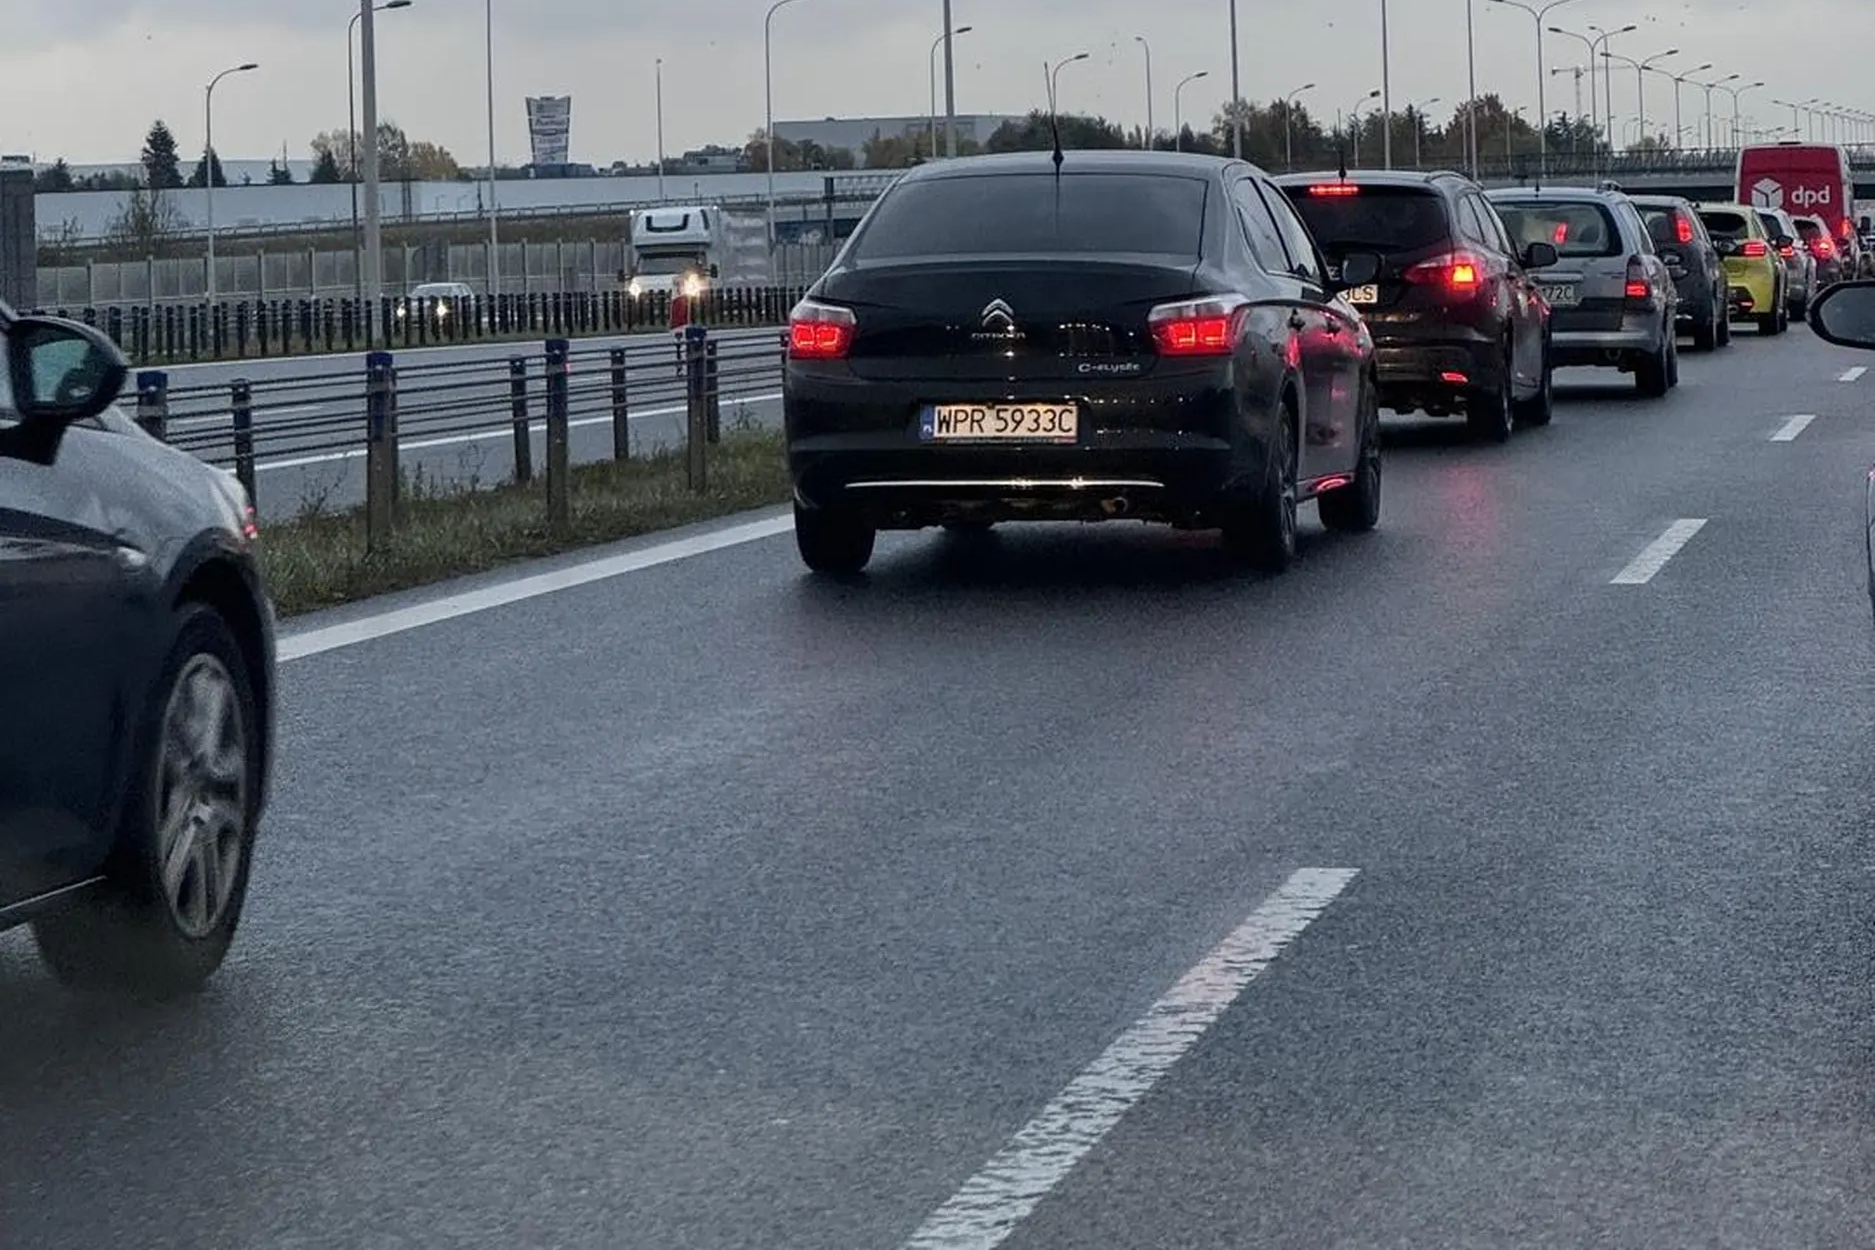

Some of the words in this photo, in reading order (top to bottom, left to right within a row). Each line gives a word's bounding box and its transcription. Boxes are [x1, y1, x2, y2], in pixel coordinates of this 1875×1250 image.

[1791, 184, 1831, 209] dpd
[937, 408, 985, 433] WPR
[995, 408, 1074, 433] 5933C
